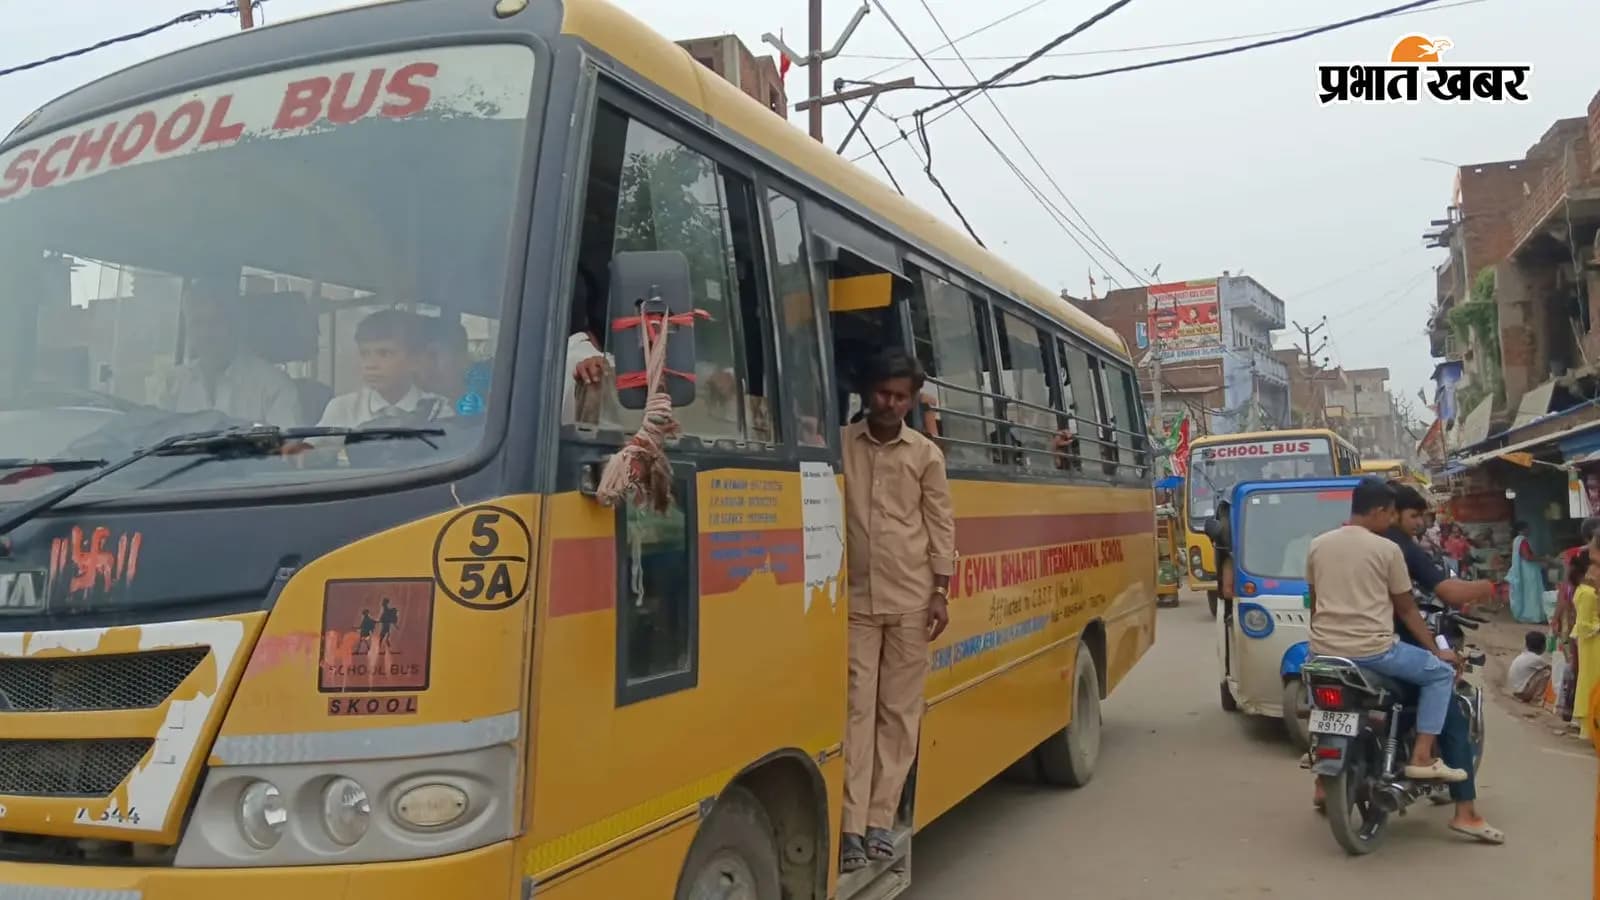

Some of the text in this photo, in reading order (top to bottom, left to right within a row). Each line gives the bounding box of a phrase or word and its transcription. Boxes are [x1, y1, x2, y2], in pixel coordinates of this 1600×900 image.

[0, 62, 439, 198] SCHOOL BUS
[1206, 442, 1311, 459] SCHOOL BUS
[469, 514, 500, 557] 5
[459, 562, 513, 600] 5A
[390, 664, 419, 675] BUS
[330, 698, 417, 714] SKOOL
